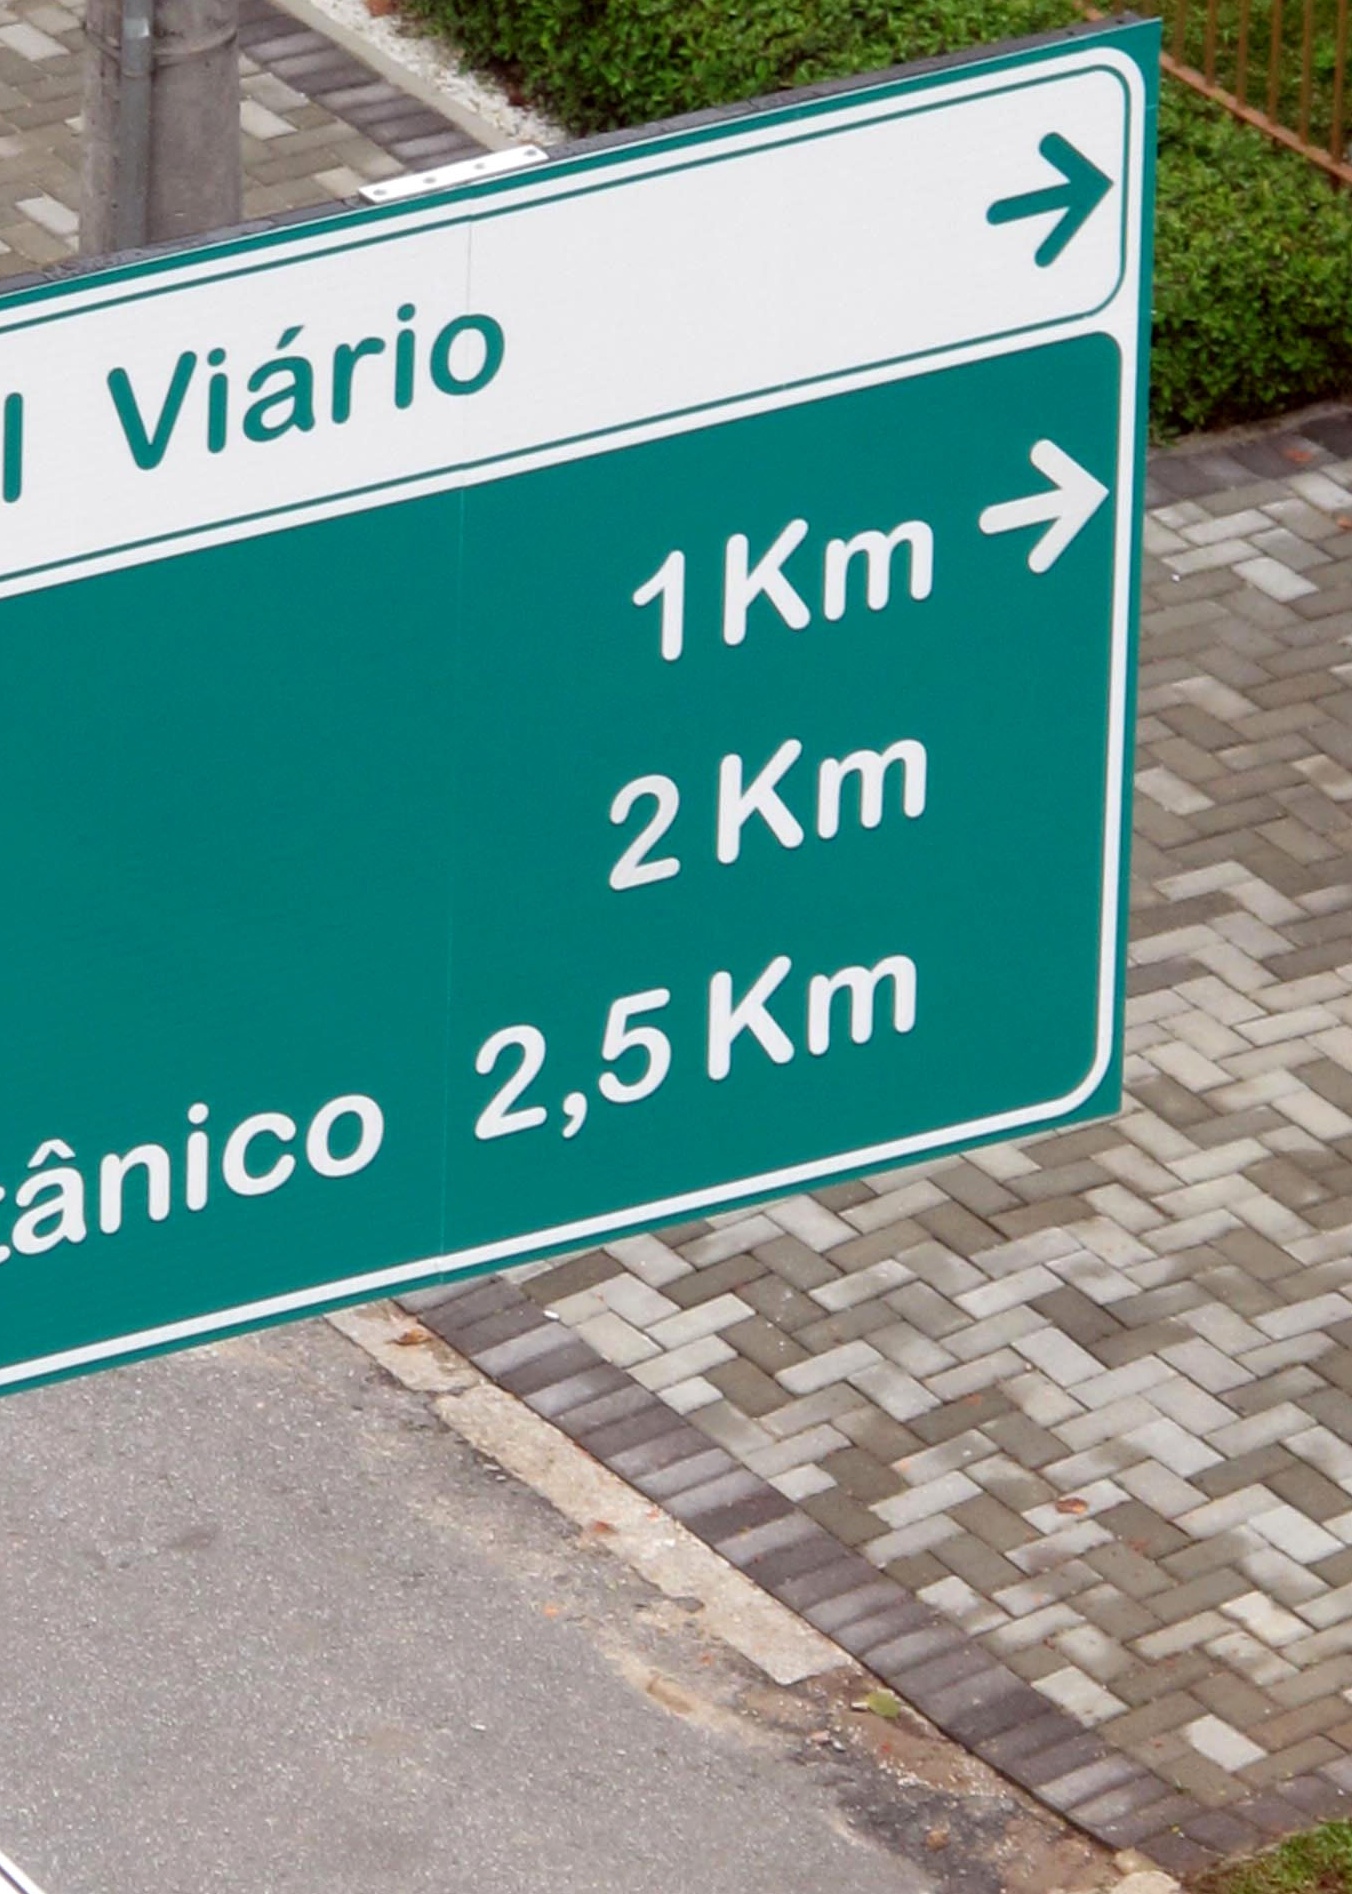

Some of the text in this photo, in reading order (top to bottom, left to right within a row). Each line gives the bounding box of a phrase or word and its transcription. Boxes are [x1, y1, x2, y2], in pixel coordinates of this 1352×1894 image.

[107, 303, 505, 471] Viário
[632, 550, 685, 661] 1
[716, 518, 934, 646] Km
[609, 774, 680, 890] 2
[717, 739, 927, 864] Km
[474, 987, 671, 1140] 2,5
[707, 955, 917, 1080] Km
